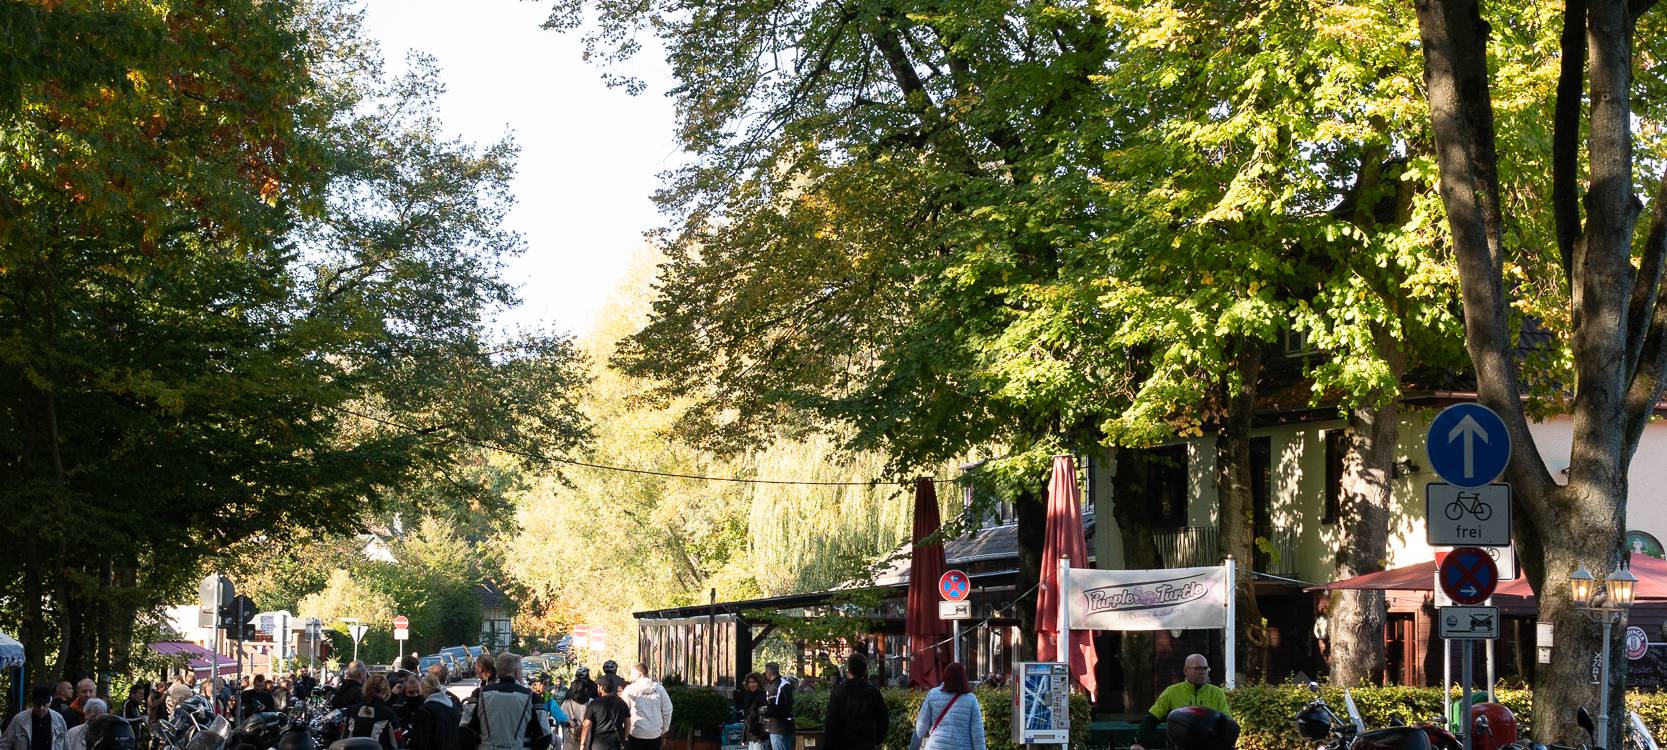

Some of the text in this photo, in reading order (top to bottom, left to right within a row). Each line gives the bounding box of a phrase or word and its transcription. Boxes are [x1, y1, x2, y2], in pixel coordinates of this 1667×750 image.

[1456, 525, 1482, 538] frei
[1091, 581, 1207, 610] Purple Turtle
